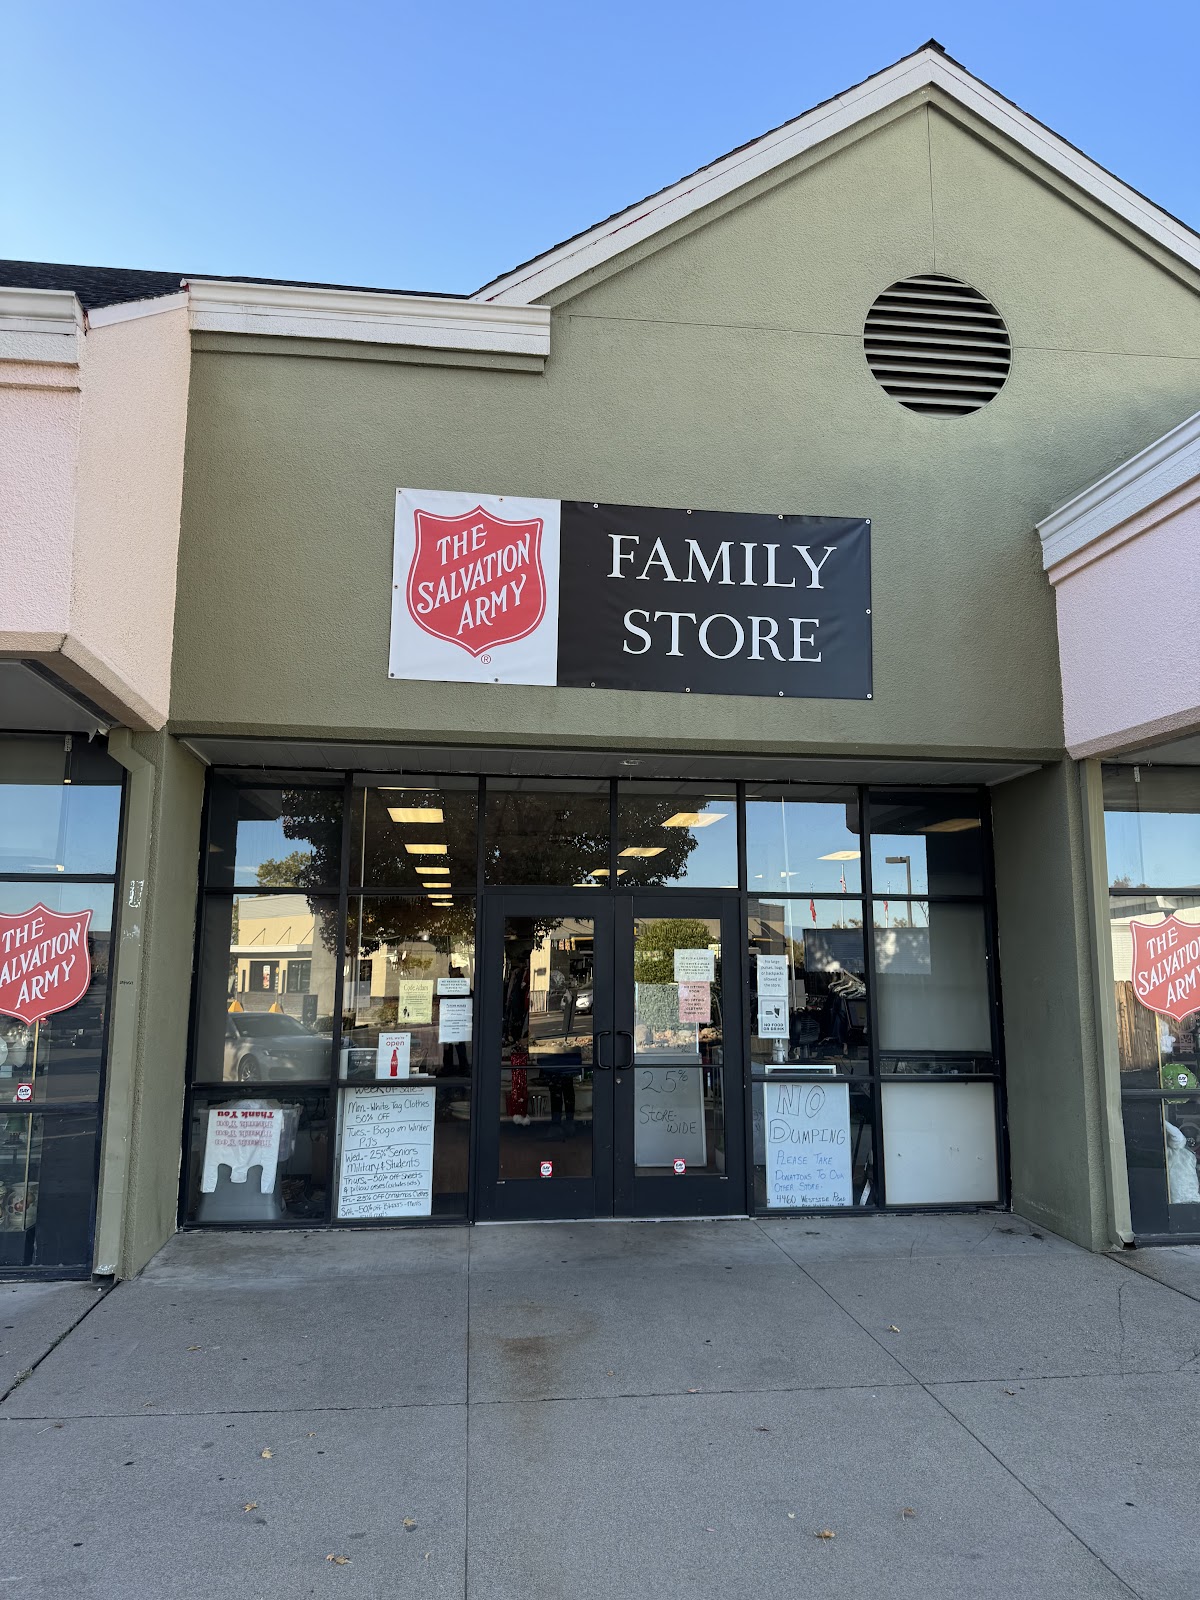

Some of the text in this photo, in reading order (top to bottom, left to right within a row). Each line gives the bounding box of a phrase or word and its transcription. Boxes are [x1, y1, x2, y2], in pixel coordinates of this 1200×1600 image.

[437, 524, 488, 566] THE
[418, 534, 531, 613] SALVATION
[607, 534, 836, 590] FAMILY
[456, 574, 527, 635] ARMY
[622, 609, 822, 663] STORE
[2, 917, 45, 954] THE
[1146, 926, 1179, 959] THE
[0, 922, 81, 988] ALVATION
[14, 954, 76, 1010] ARMY
[642, 1069, 689, 1094] 25%
[371, 1102, 390, 1111] White
[391, 1101, 402, 1113] Tag
[404, 1098, 430, 1109] Clothes
[776, 1084, 826, 1118] NO
[217, 1111, 275, 1119] Thank You
[355, 1114, 373, 1123] 50%
[373, 1125, 395, 1138] Bogo
[408, 1122, 430, 1131] Winter
[769, 1118, 846, 1145] DUMPING
[347, 1162, 379, 1174] Military
[386, 1157, 421, 1171] Students
[370, 1149, 386, 1159] 25%
[388, 1147, 418, 1157] Seniors
[776, 1150, 833, 1165] PLEASE TAKE
[774, 1182, 794, 1192] OTHER
[775, 1169, 812, 1182] DONATIONS
